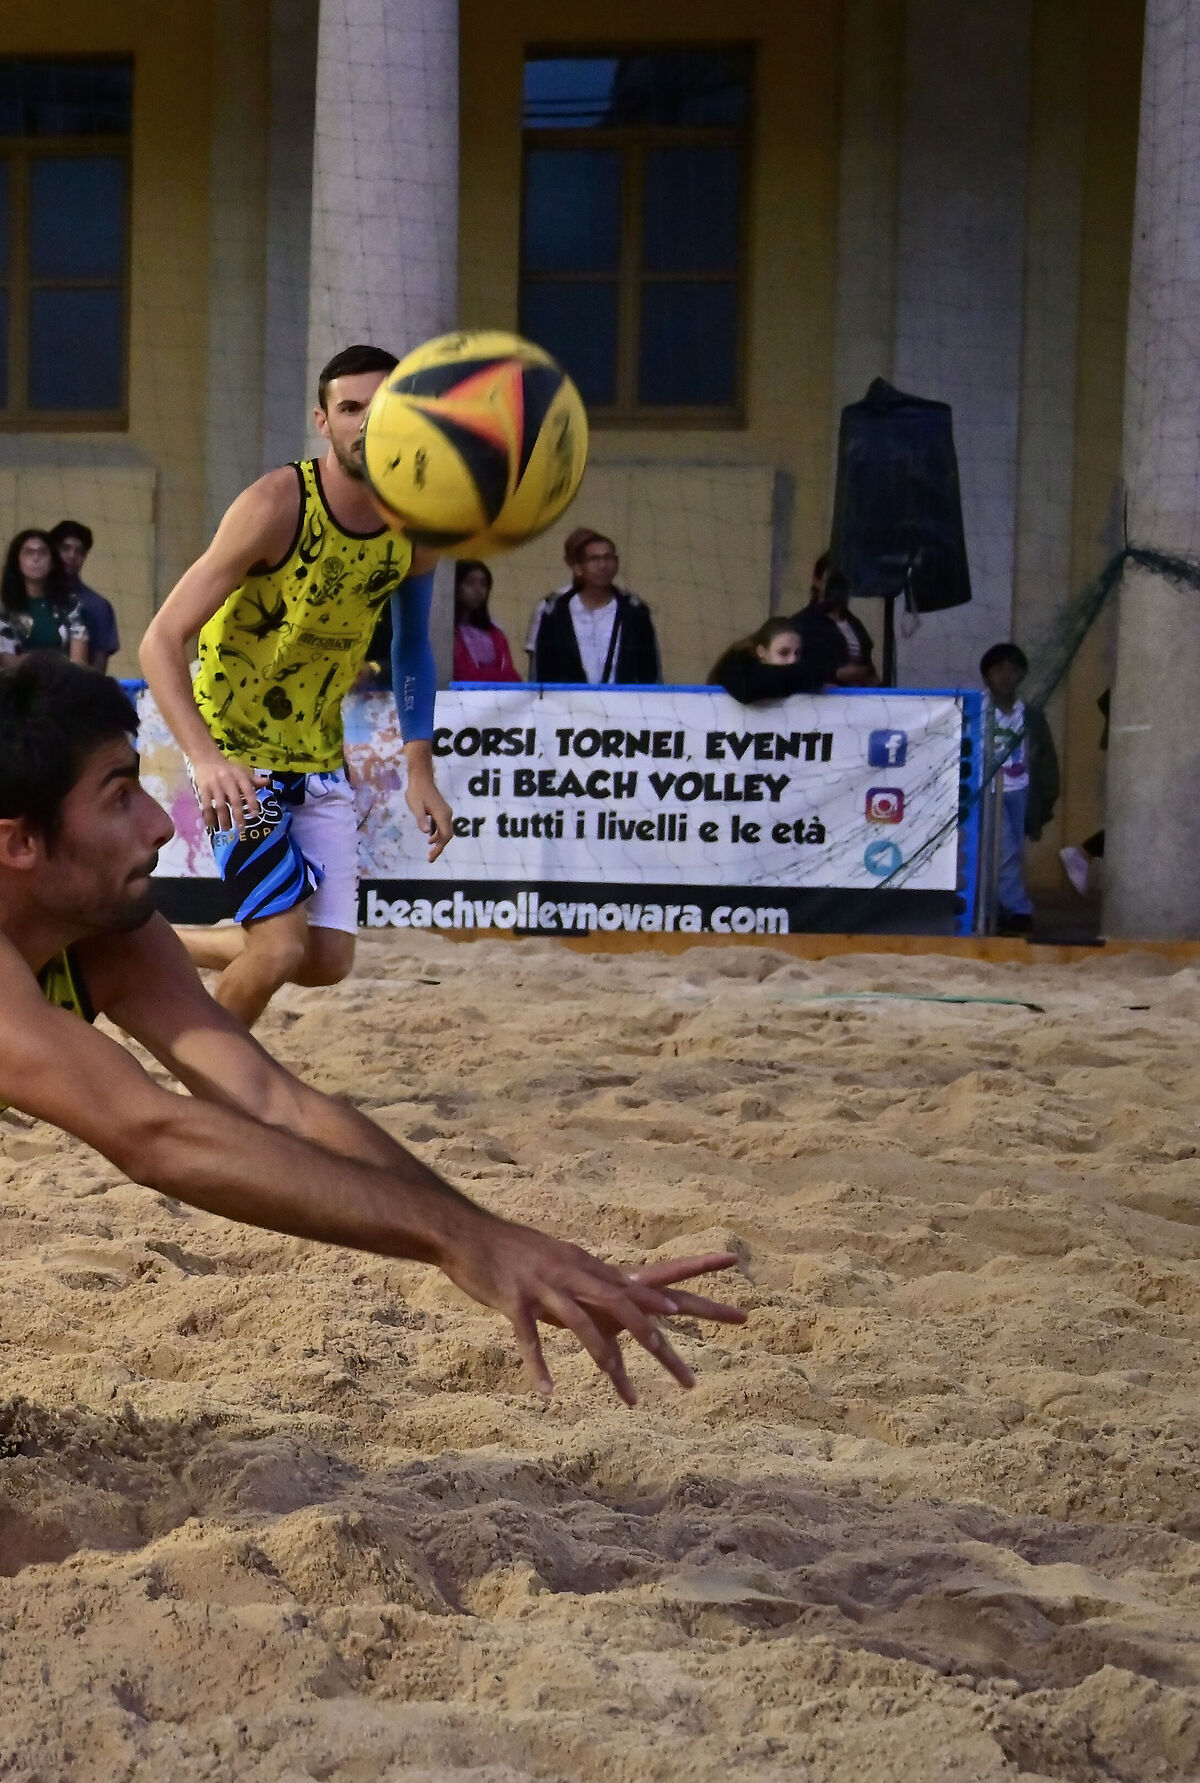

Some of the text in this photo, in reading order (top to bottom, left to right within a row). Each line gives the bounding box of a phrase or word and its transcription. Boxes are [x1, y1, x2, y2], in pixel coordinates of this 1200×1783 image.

[706, 731, 834, 762] EVENTI
[468, 768, 791, 802] di BEACH VOLLEY
[431, 811, 826, 845] er tutti i livelli e le età
